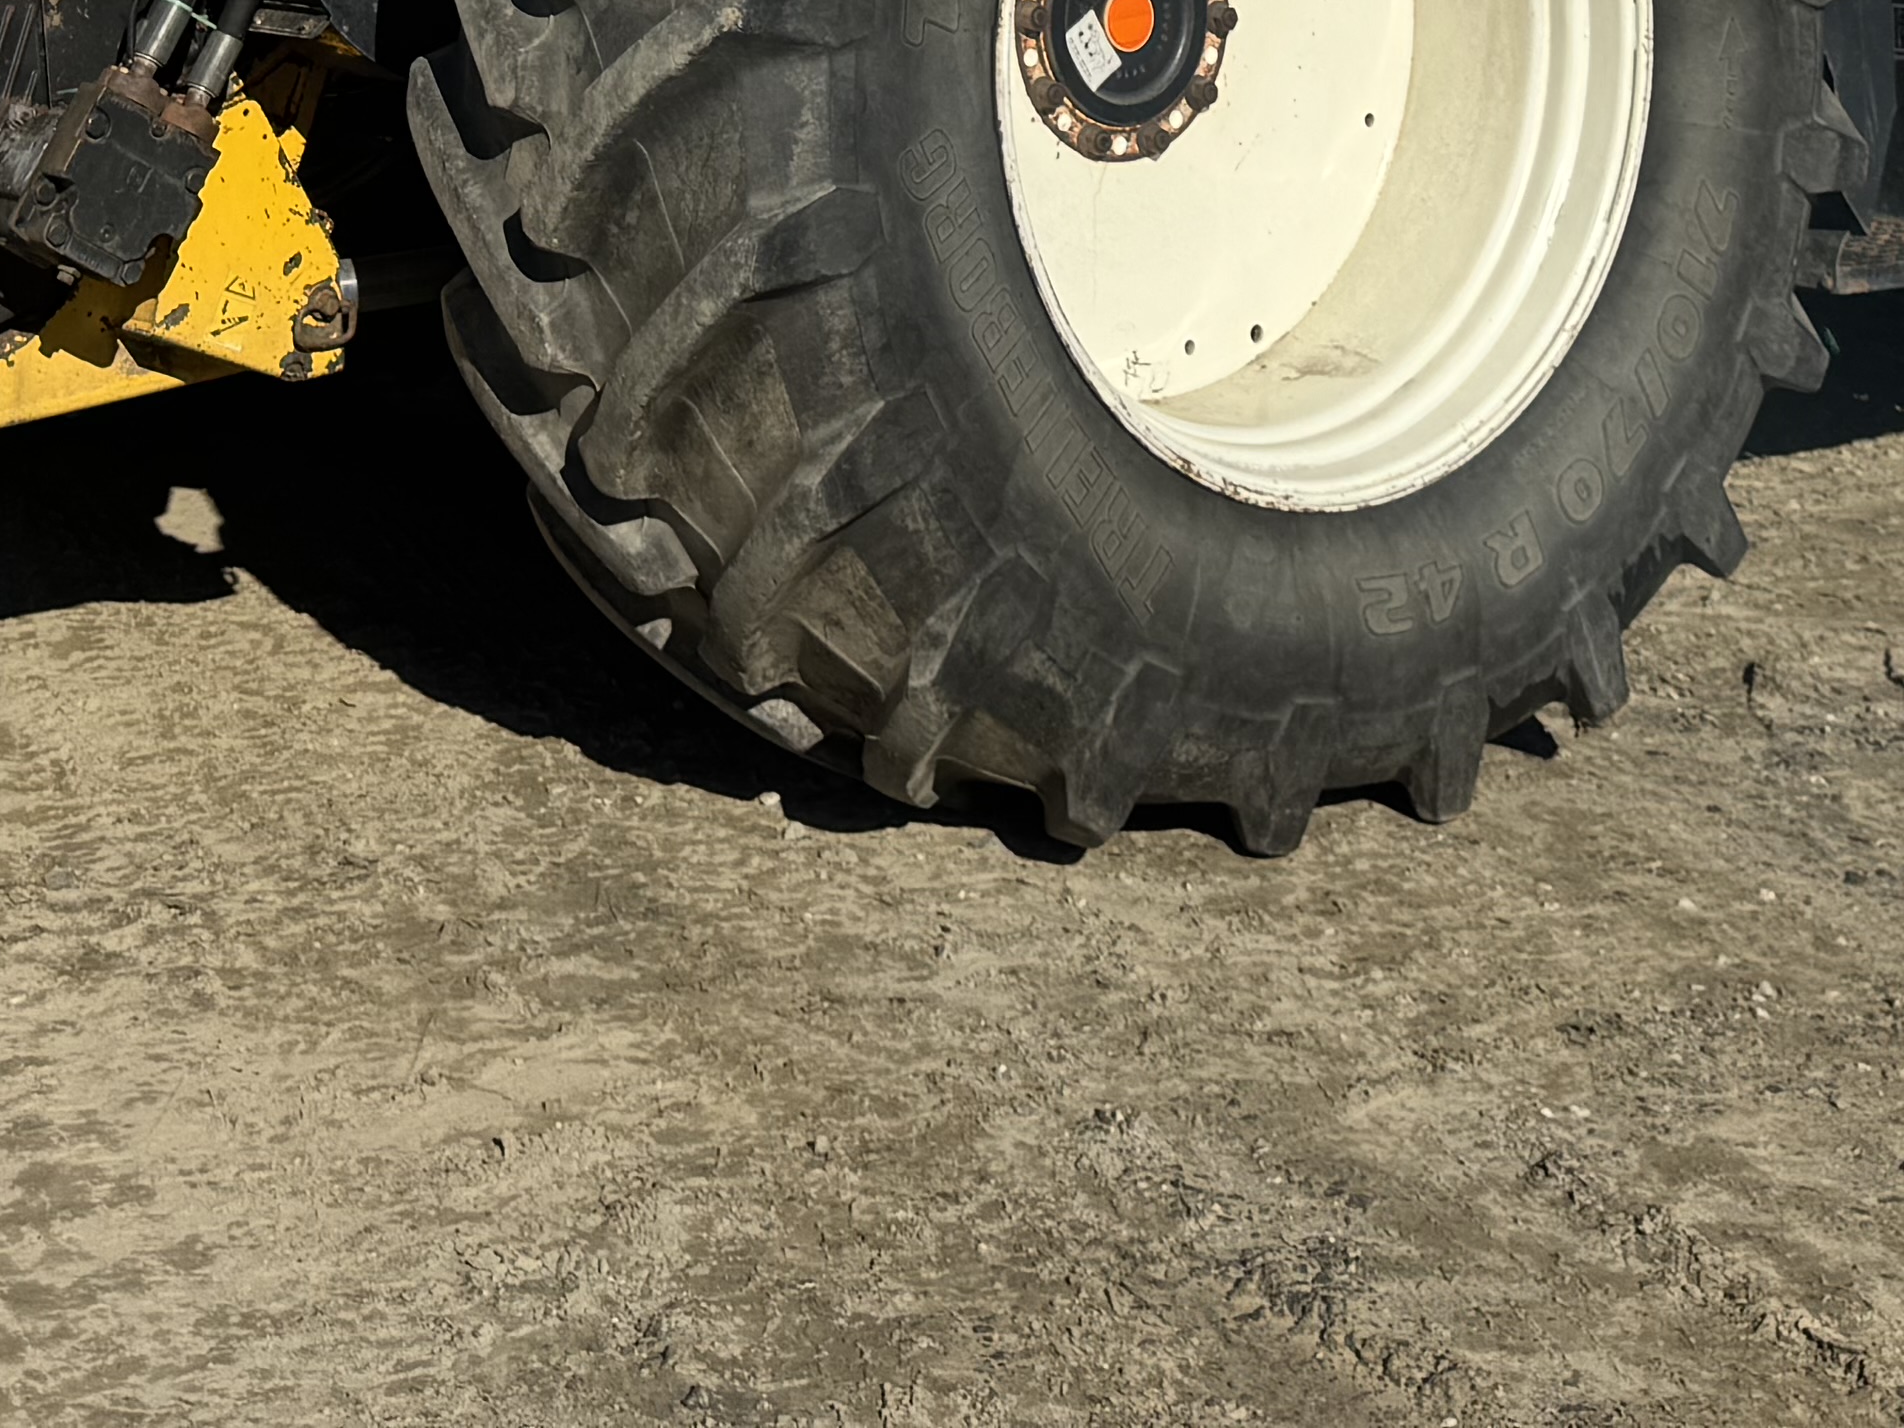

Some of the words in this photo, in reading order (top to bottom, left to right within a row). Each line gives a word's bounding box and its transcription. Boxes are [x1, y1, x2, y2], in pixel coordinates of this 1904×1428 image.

[899, 127, 1176, 628] TRELLEBORG
[1556, 178, 1740, 526] 710/70
[1355, 559, 1464, 638] 42
[1483, 508, 1545, 590] R
